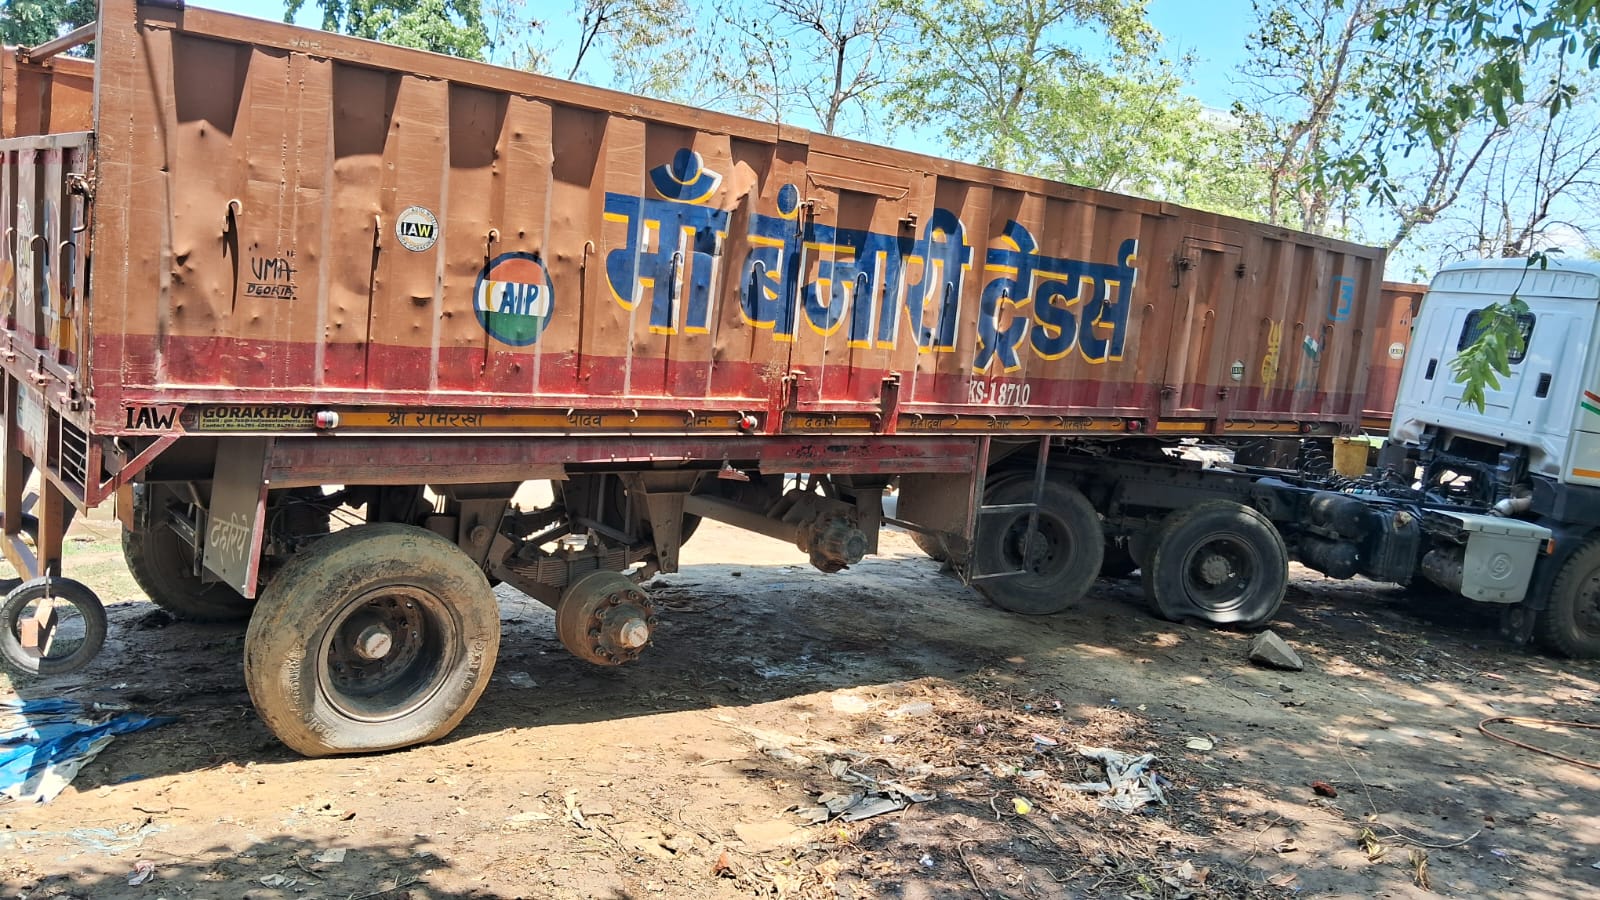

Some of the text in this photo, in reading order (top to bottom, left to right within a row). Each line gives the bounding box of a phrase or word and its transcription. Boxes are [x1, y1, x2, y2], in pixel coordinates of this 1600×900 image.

[402, 222, 431, 238] IAW
[602, 147, 732, 335] माँ
[124, 406, 177, 430] IAW
[202, 406, 314, 419] GORAKHPUR
